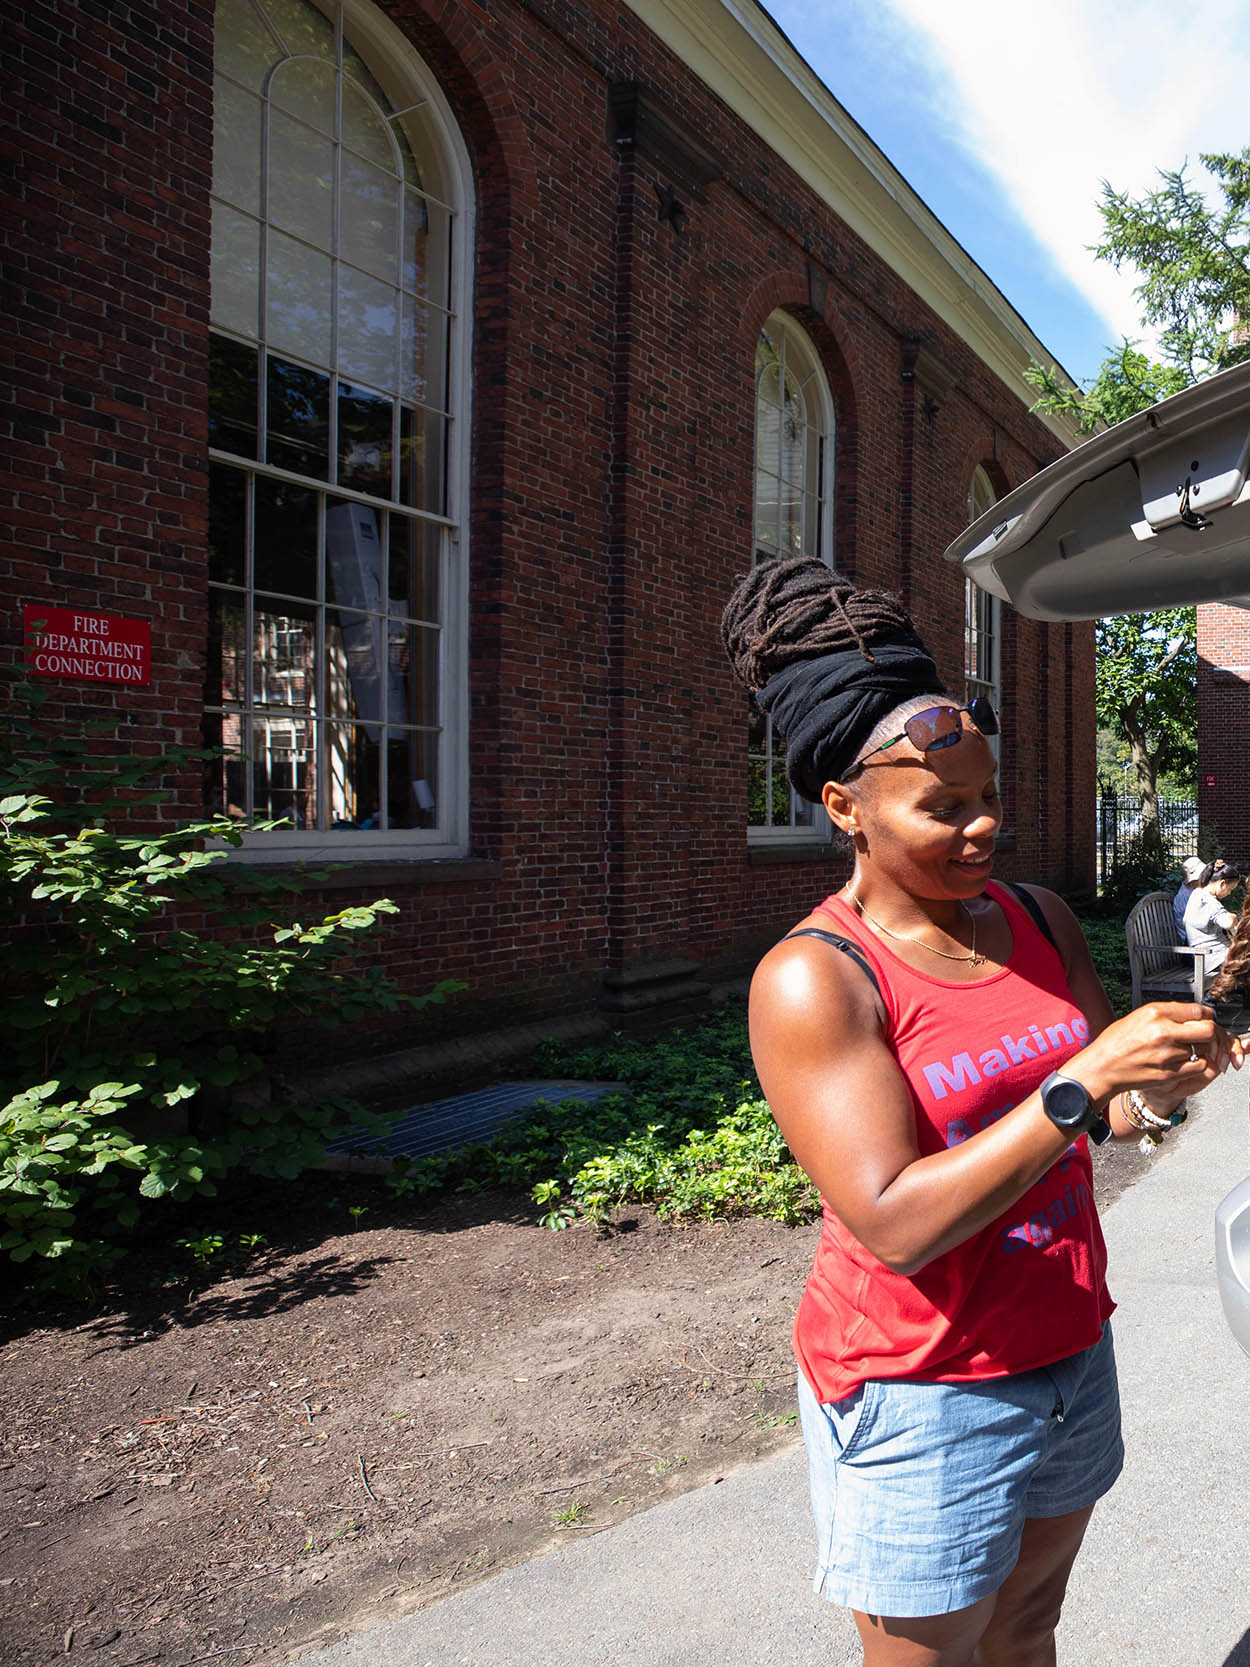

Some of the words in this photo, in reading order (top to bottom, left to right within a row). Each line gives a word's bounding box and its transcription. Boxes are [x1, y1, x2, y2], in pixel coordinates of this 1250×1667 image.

[73, 615, 110, 636] FIRE
[35, 632, 144, 661] DEPARTMENT
[35, 654, 143, 681] CONNECTION
[922, 1016, 1090, 1100] Making
